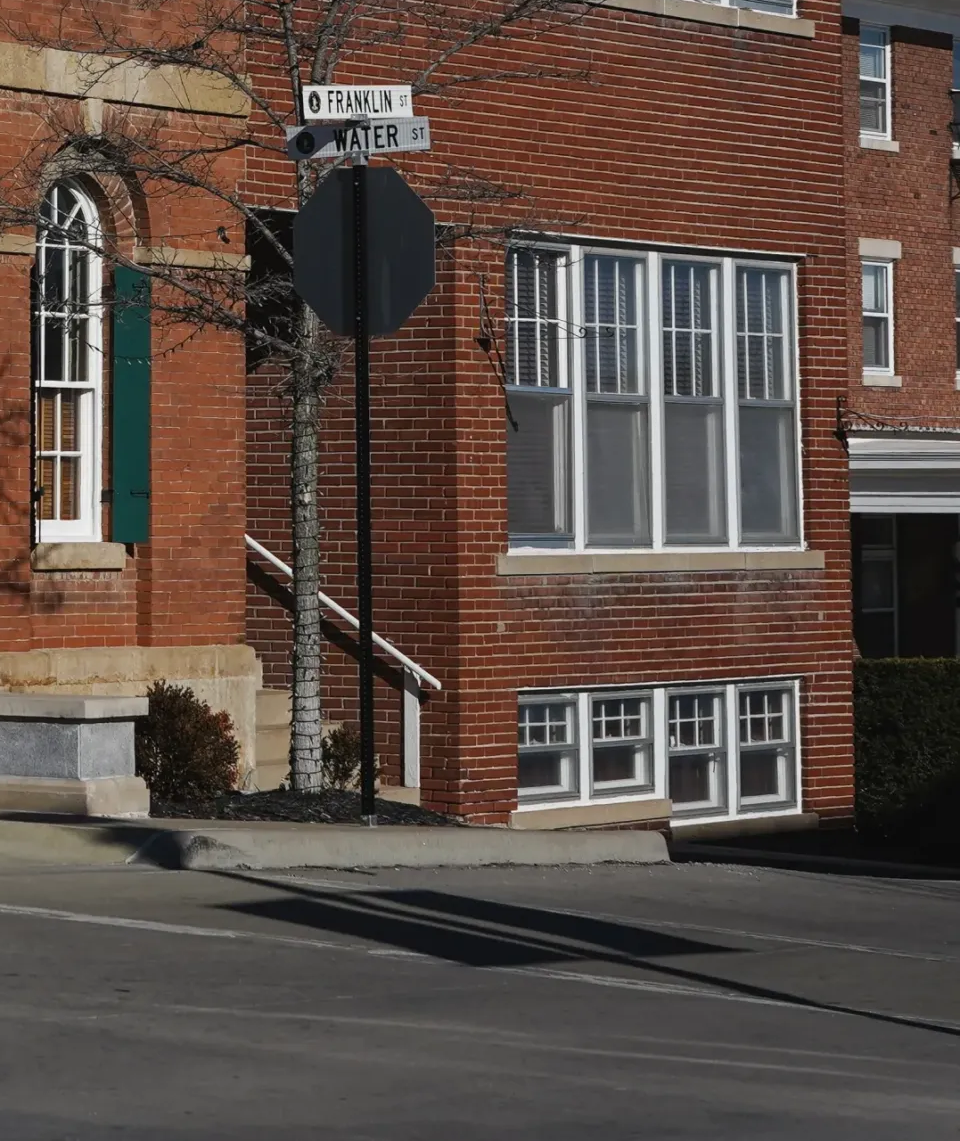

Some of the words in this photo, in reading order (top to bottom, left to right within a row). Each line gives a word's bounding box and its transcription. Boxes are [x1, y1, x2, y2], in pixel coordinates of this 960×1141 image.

[327, 90, 393, 113] FRANKLIN
[399, 95, 408, 107] ST
[334, 124, 399, 152] WATER
[412, 127, 425, 141] ST
